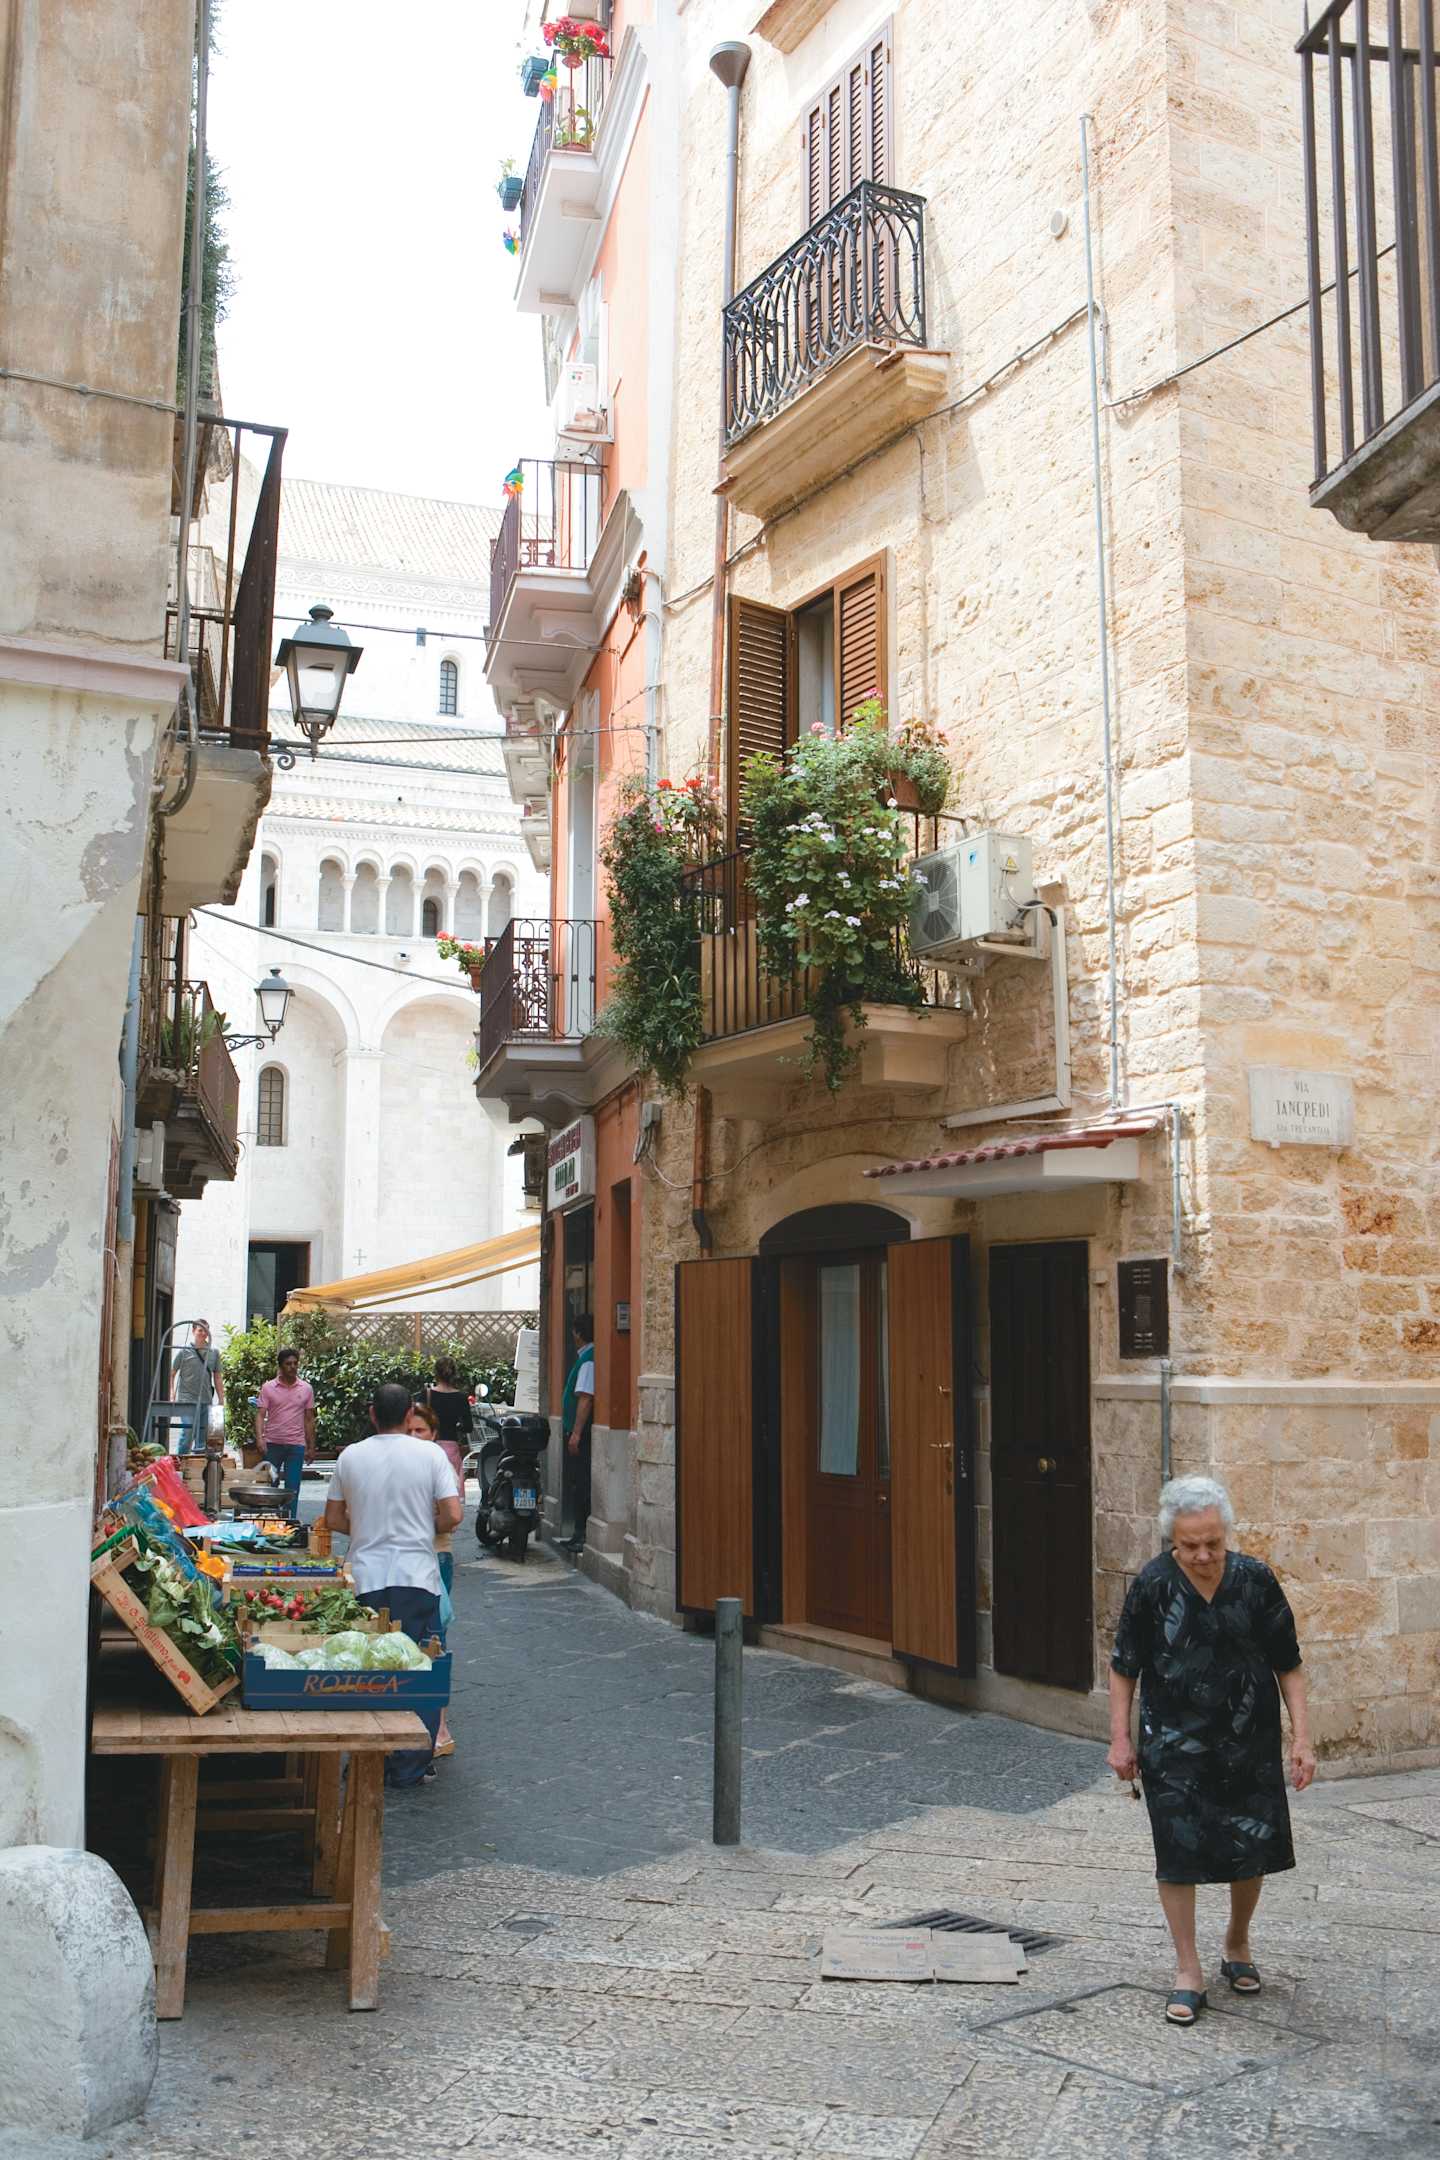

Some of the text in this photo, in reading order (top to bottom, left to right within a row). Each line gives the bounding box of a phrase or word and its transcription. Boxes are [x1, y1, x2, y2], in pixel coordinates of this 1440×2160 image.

[1295, 1080, 1310, 1094] VIA
[1276, 1100, 1330, 1118] TANCREDI
[303, 1674, 399, 1693] ROTECA
